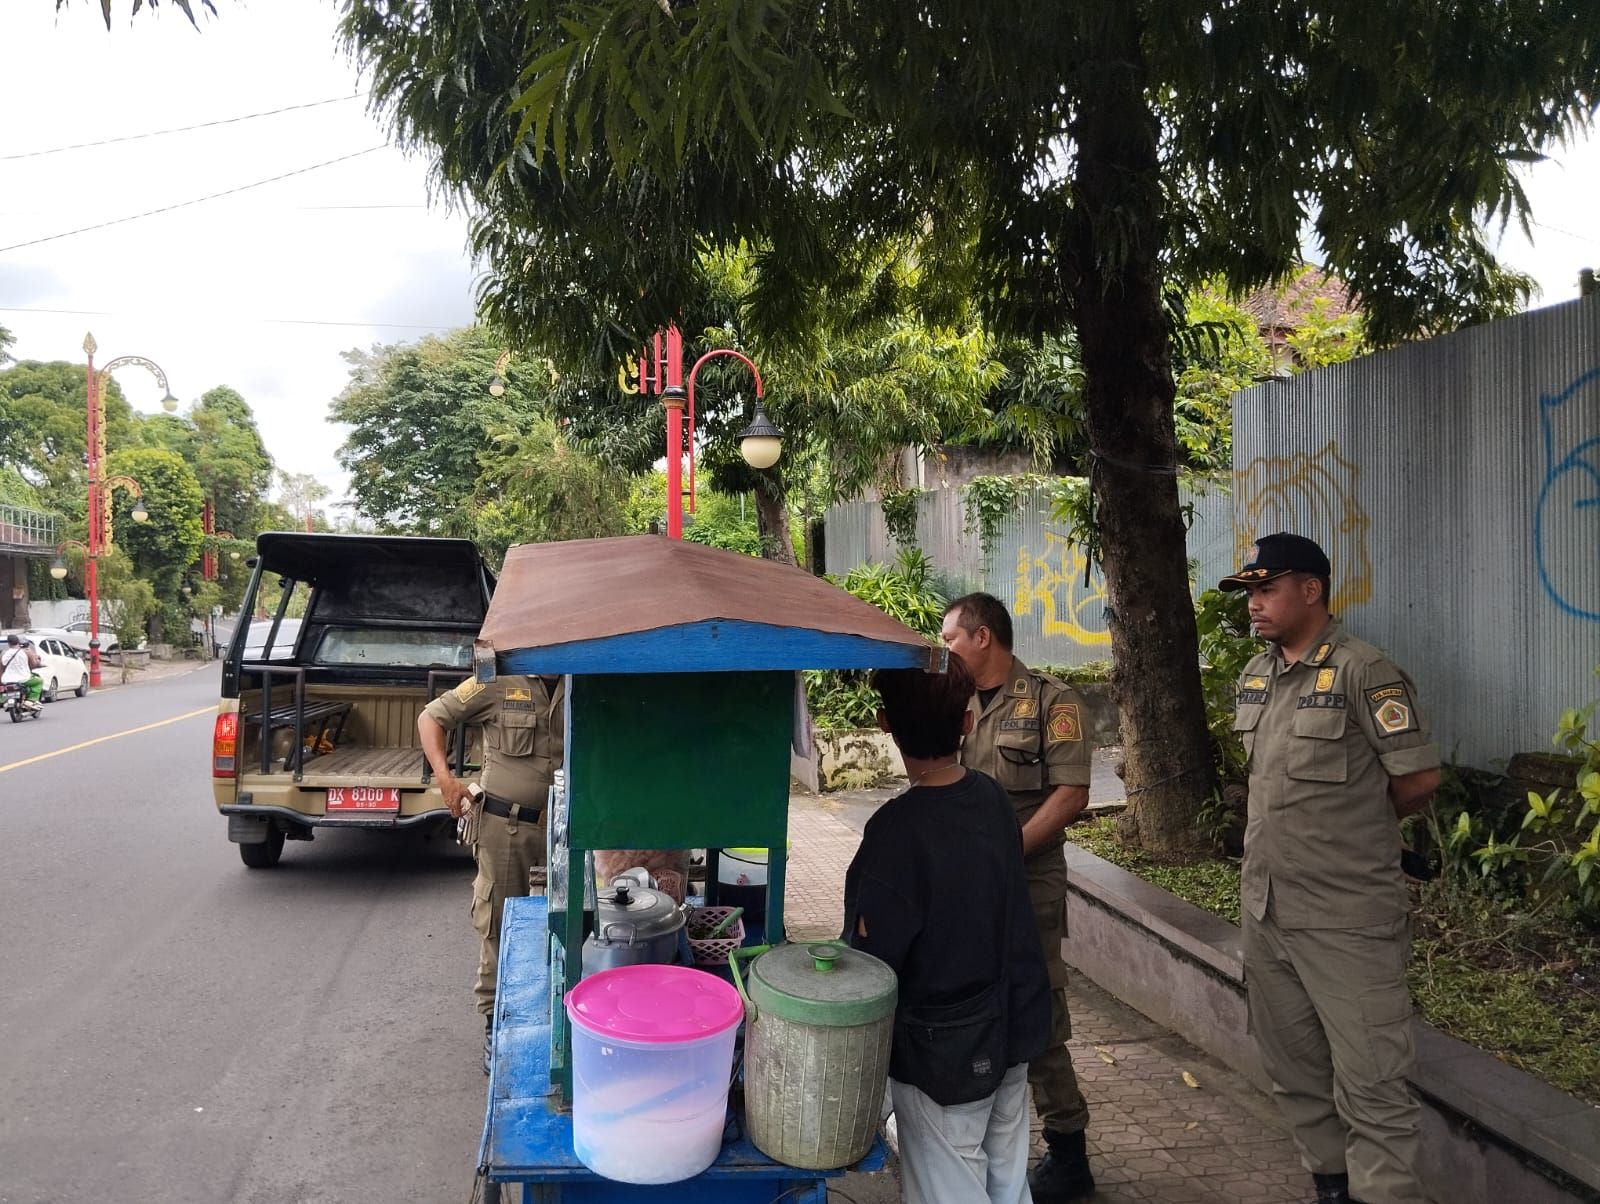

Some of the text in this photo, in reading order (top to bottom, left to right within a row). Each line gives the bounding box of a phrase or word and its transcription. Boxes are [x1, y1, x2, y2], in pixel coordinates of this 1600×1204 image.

[1298, 695, 1343, 707] POL PP
[328, 788, 399, 801] DK 8100 K
